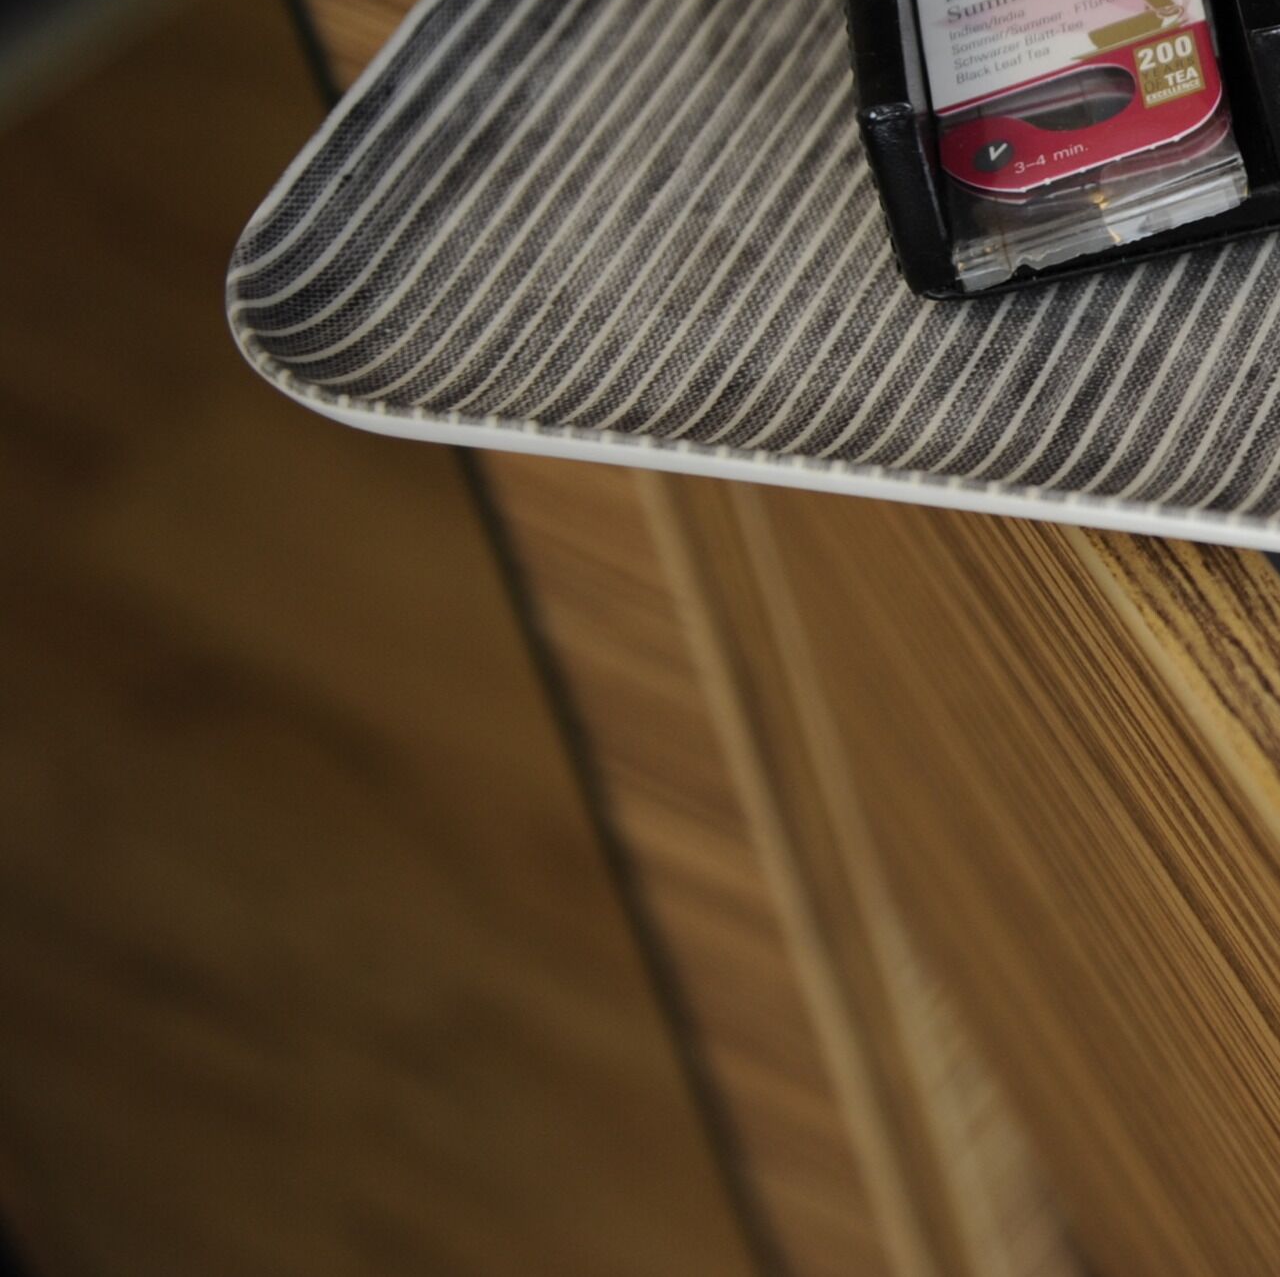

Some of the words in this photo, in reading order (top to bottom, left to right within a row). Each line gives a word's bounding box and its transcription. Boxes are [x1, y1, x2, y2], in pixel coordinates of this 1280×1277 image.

[1137, 35, 1193, 71] 200
[955, 65, 991, 86] Black
[1163, 66, 1199, 86] TEA
[1053, 143, 1089, 162] min.
